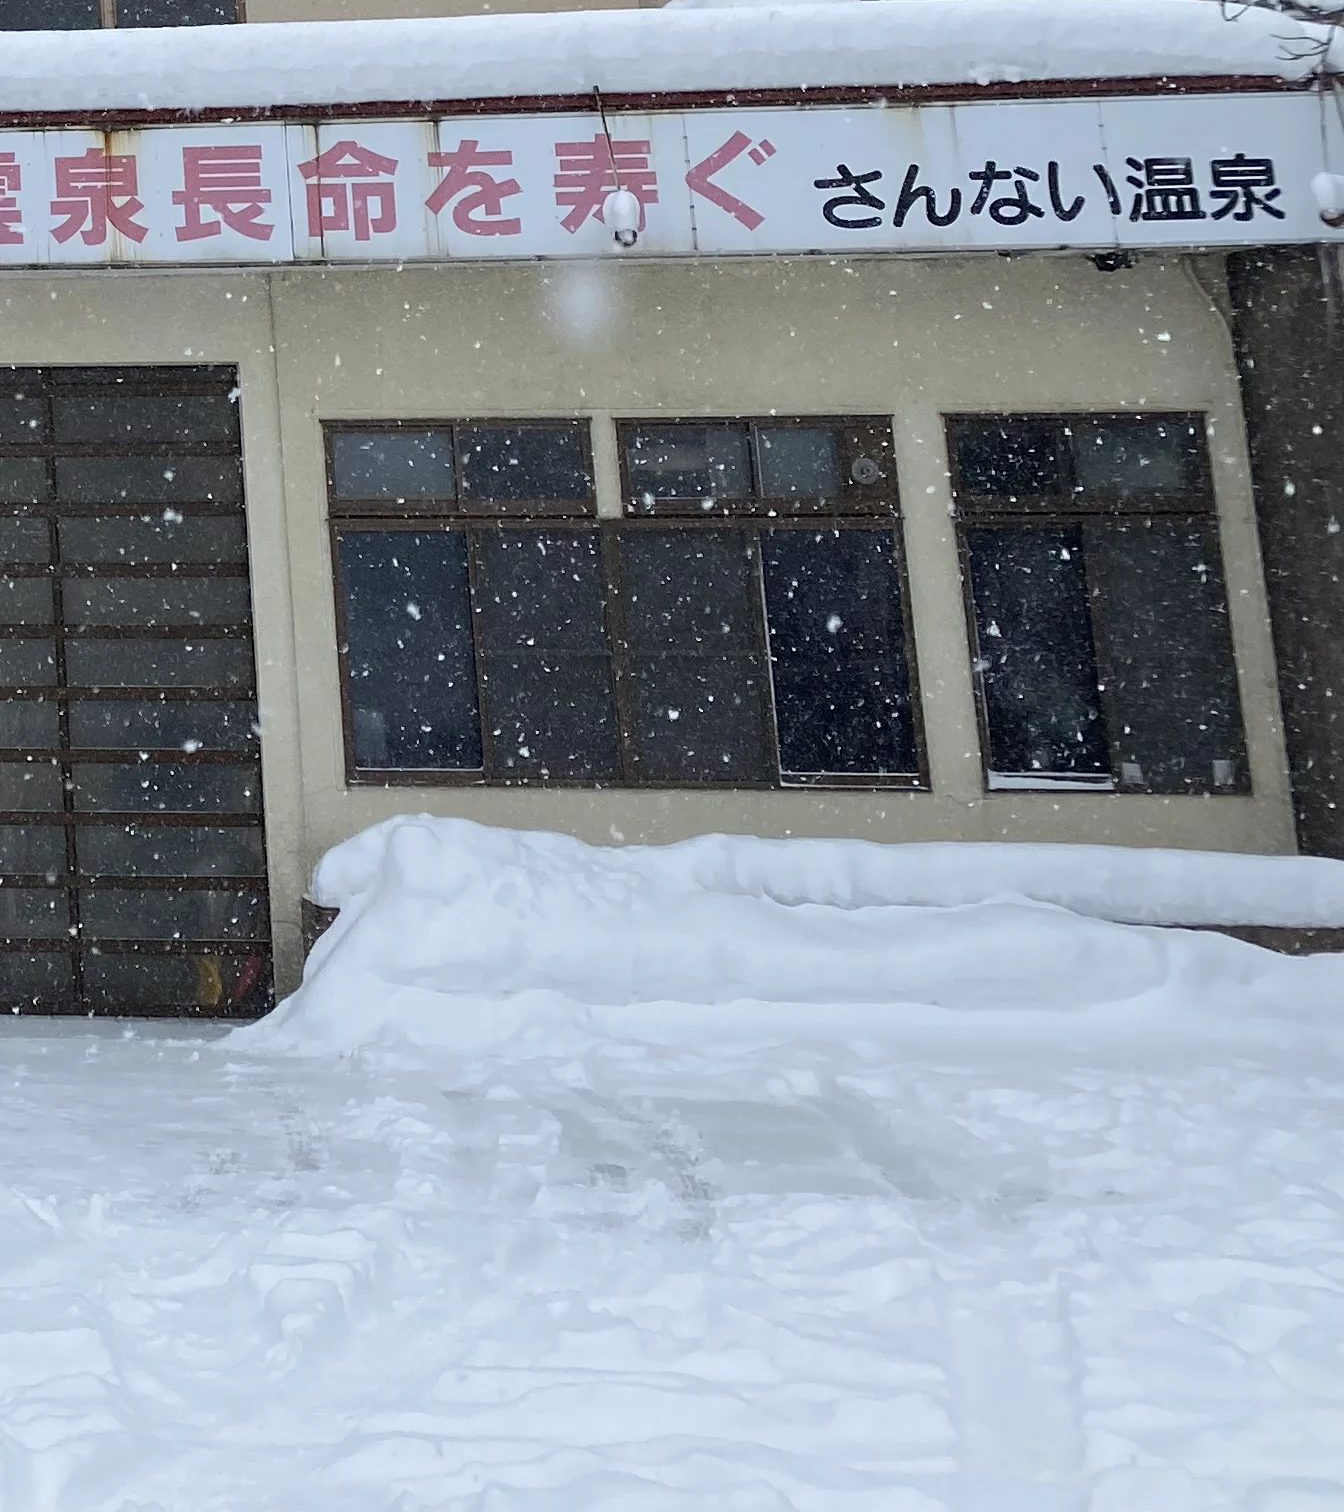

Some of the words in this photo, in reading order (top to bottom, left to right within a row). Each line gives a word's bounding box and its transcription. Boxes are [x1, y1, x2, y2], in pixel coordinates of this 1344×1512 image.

[813, 152, 1286, 229] さんない温泉
